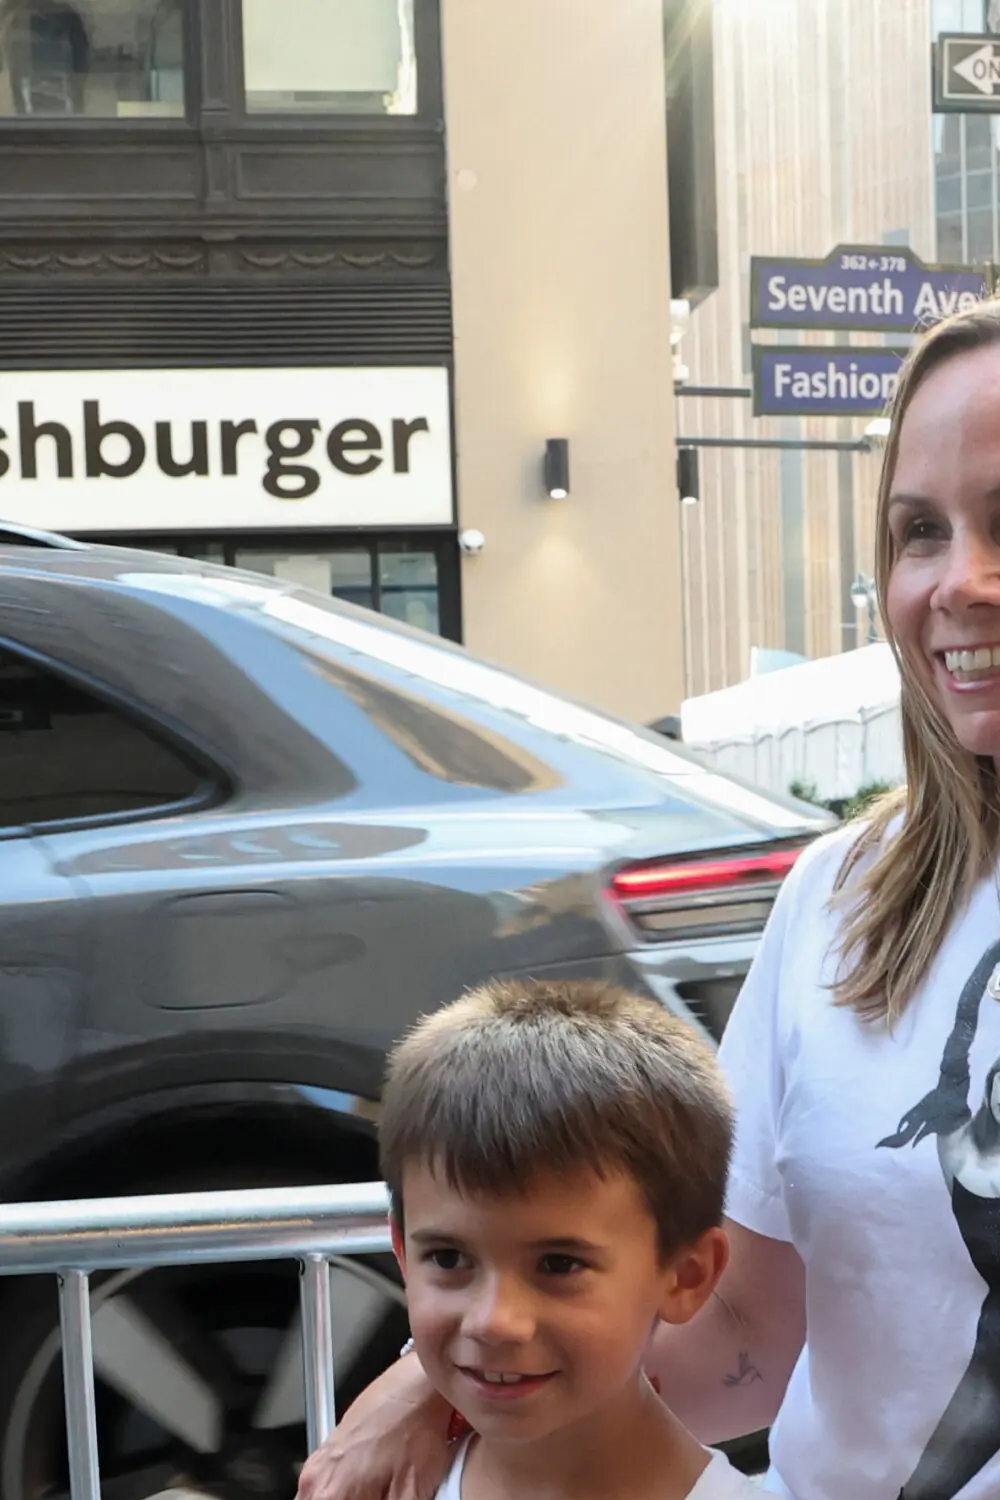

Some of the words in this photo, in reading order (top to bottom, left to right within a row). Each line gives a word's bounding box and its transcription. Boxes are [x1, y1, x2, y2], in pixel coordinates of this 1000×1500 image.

[768, 276, 904, 315] Seventh
[913, 282, 977, 317] Ave
[0, 399, 429, 500] hburger
